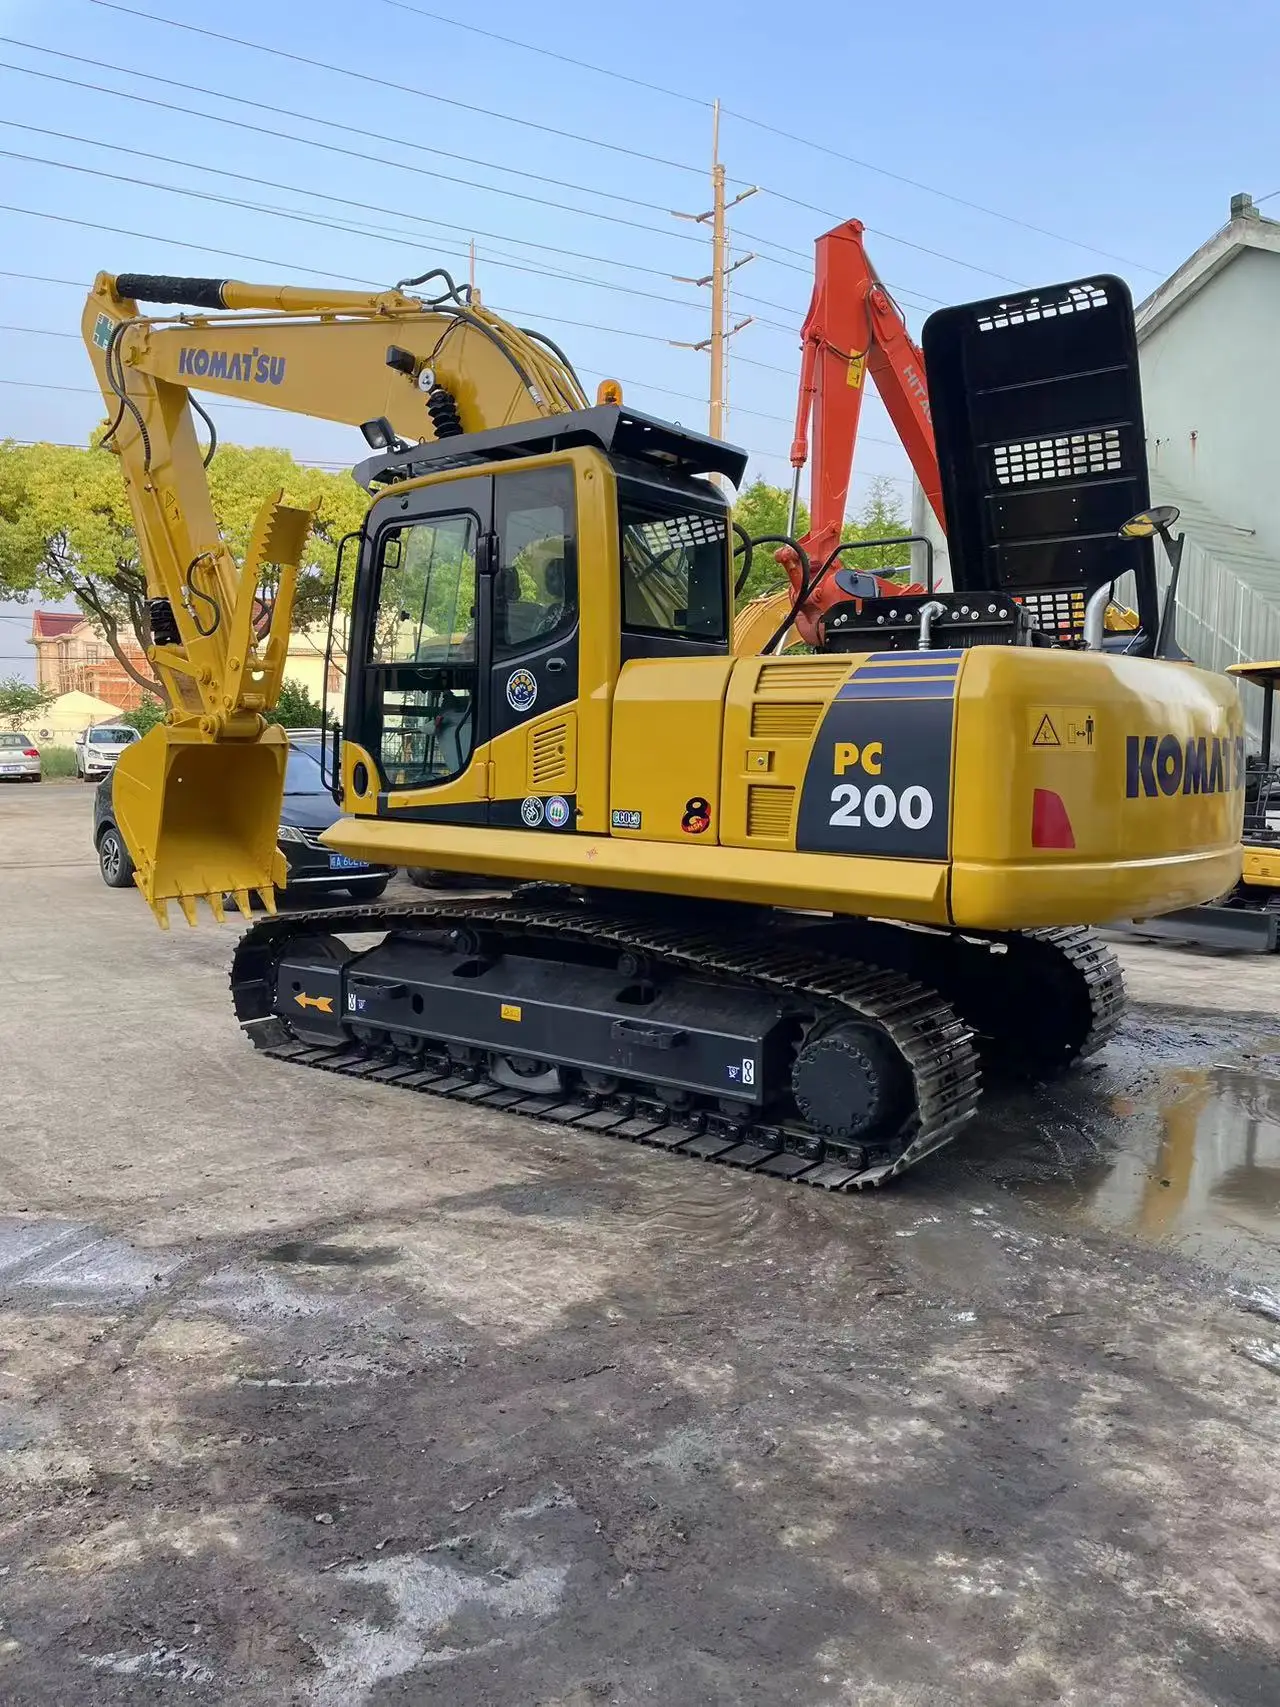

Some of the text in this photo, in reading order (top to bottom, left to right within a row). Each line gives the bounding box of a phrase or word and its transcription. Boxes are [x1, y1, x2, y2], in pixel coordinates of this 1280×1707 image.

[178, 346, 286, 385] KOMATSU
[833, 741, 883, 776] PC
[681, 796, 711, 834] 8
[828, 783, 934, 830] 200
